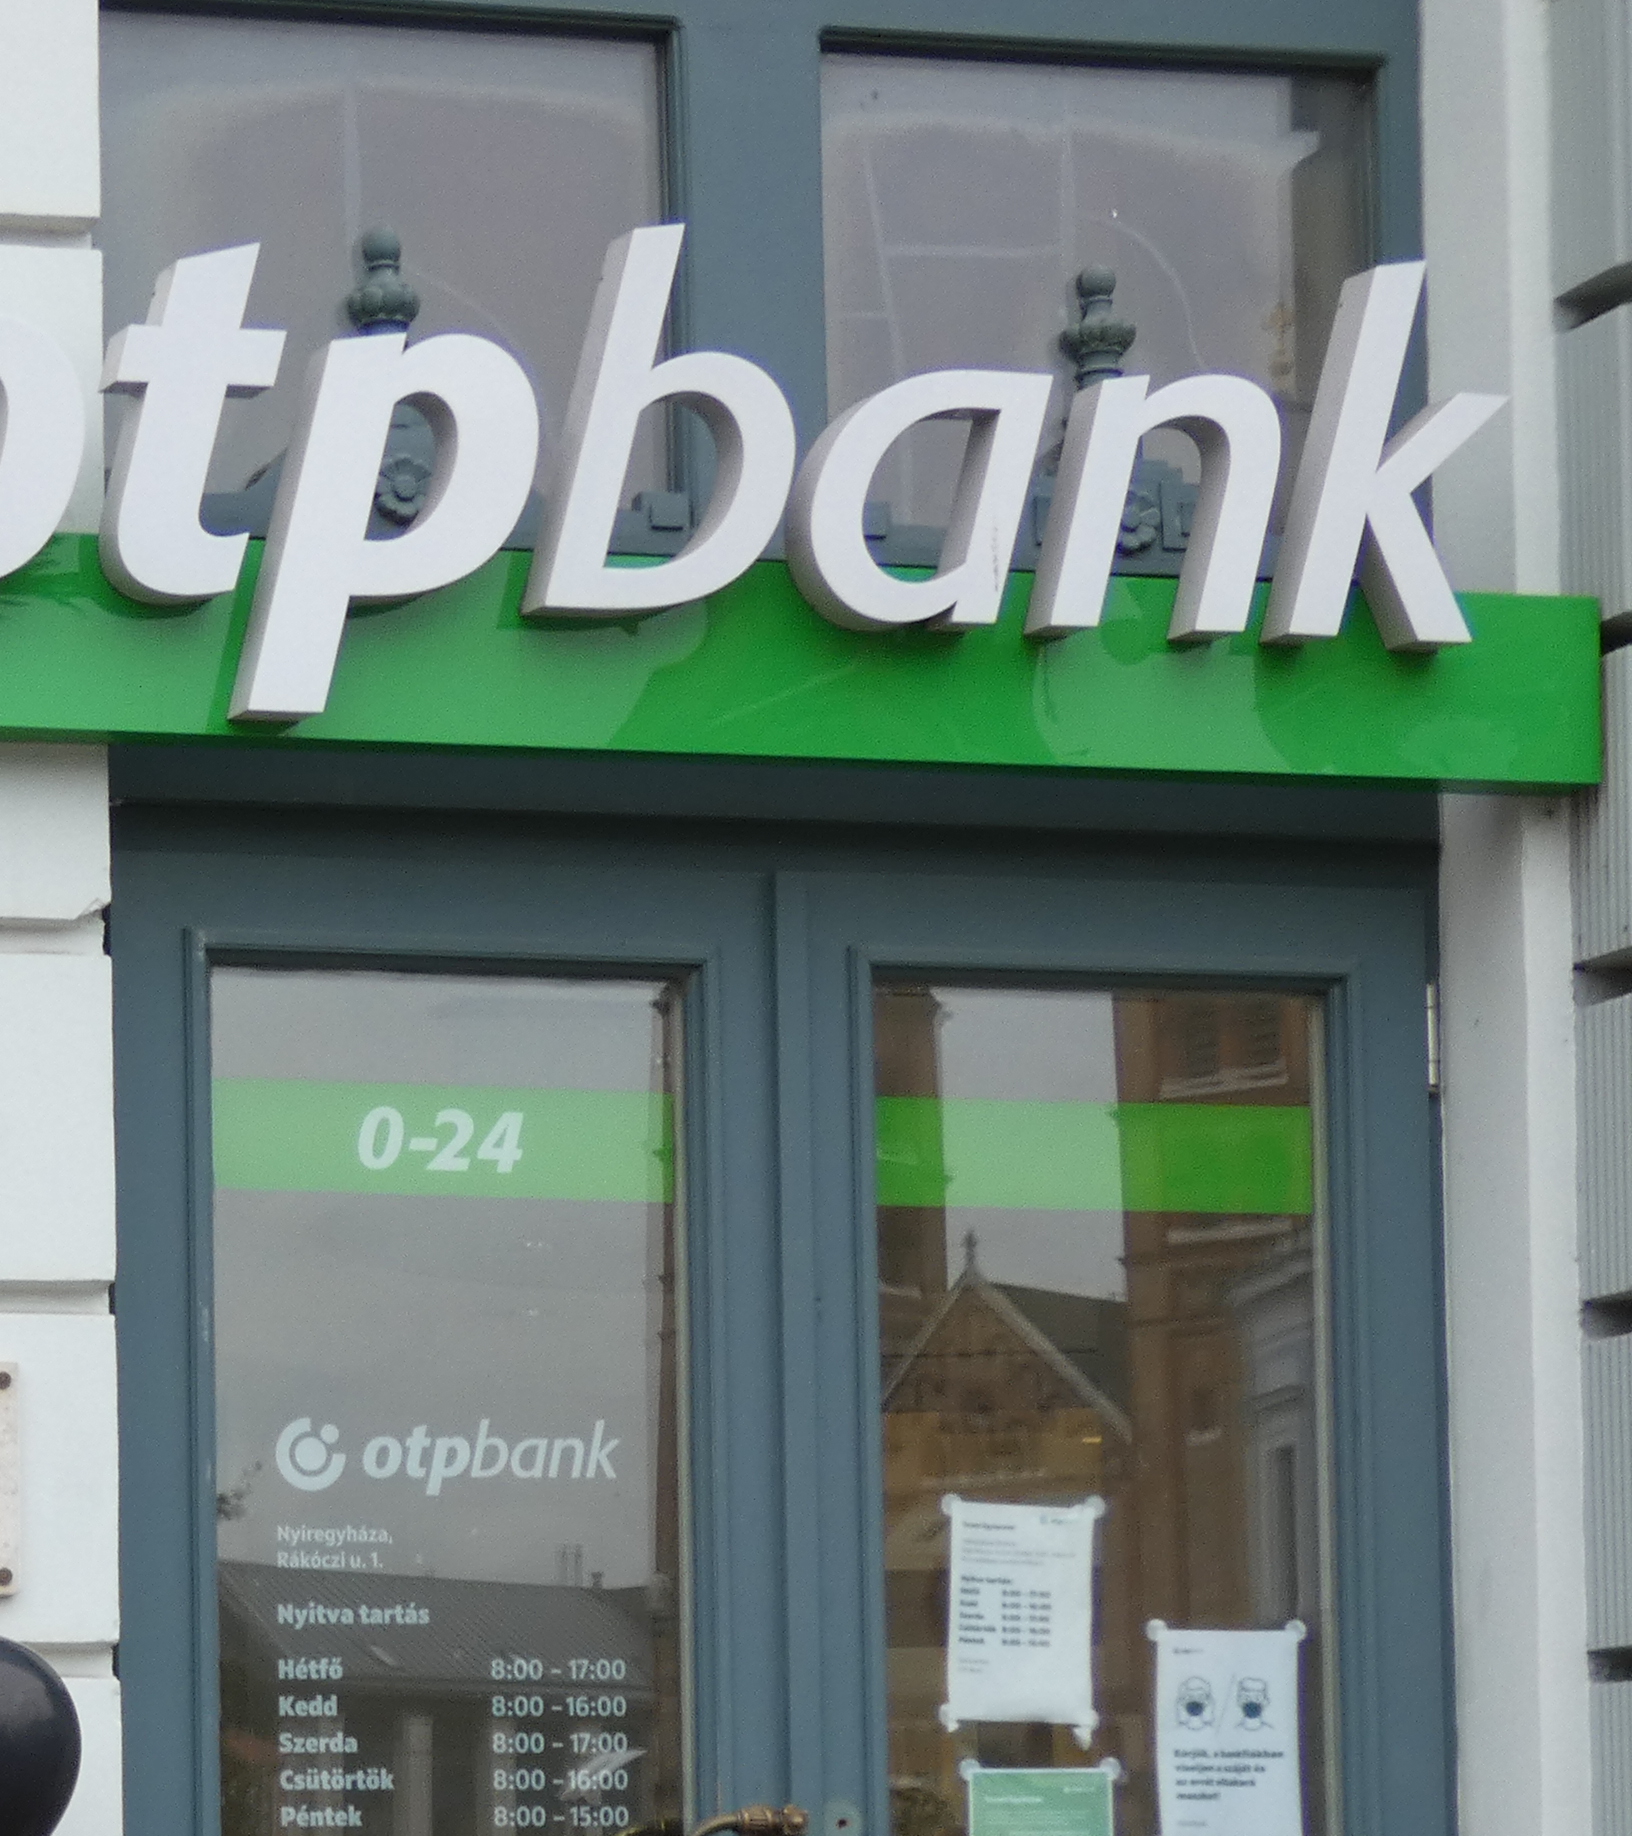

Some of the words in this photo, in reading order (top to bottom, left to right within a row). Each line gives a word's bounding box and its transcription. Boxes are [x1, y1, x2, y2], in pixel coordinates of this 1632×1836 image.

[356, 1105, 525, 1174] 0-24
[362, 1418, 623, 1496] otpbank
[351, 1555, 368, 1569] u.
[277, 1602, 355, 1630] Nyitva
[359, 1602, 431, 1625] tartás
[278, 1658, 344, 1681] Hétfő
[490, 1658, 544, 1681] 8:00
[568, 1658, 627, 1681] 17:00
[278, 1695, 338, 1717] Kedd
[491, 1695, 545, 1718] 8:00
[566, 1695, 628, 1718] 16:00
[279, 1732, 359, 1754] Szerda
[492, 1732, 546, 1755] 8:00
[568, 1732, 629, 1755] 17:00
[279, 1768, 395, 1791] Csütörtök
[493, 1769, 546, 1791] 8:00
[568, 1769, 629, 1791] 16:00
[280, 1804, 363, 1828] Péntek
[494, 1805, 547, 1828] 8:00
[570, 1805, 630, 1828] 15:00
